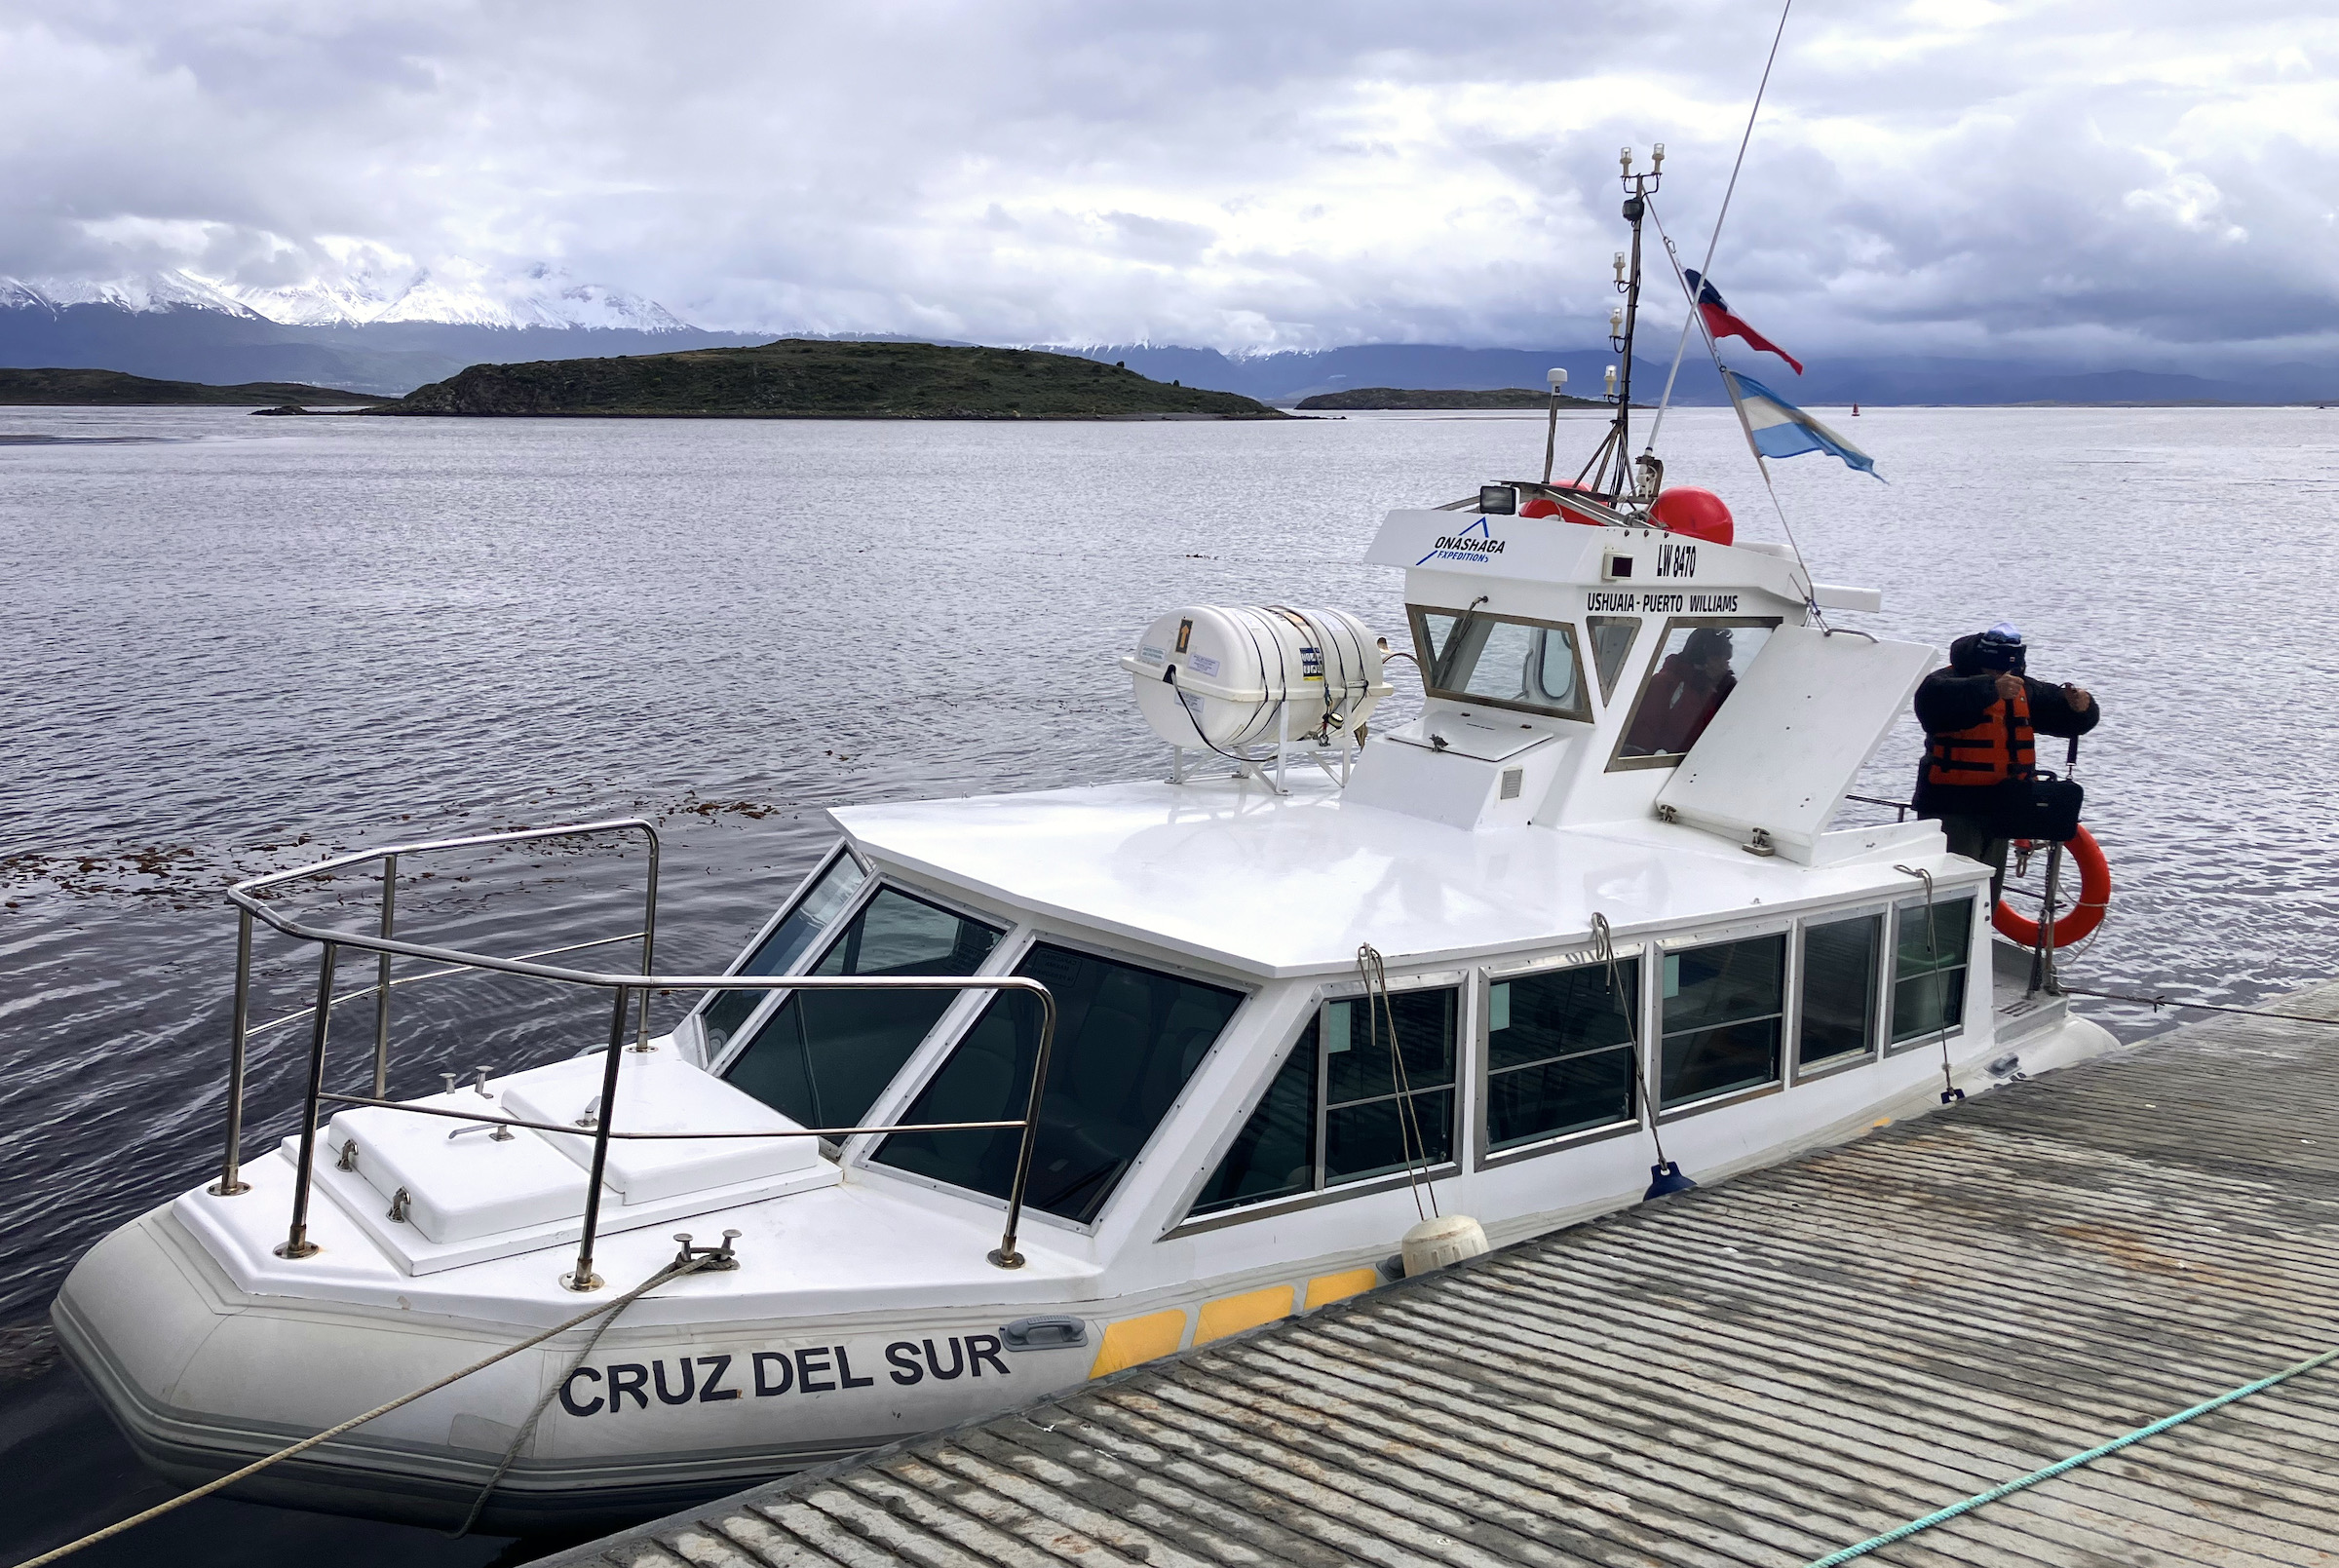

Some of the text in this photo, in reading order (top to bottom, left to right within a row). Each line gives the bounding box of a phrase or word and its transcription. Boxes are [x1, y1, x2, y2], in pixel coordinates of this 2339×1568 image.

[1435, 536, 1506, 555] ONASHAGA
[1657, 544, 1697, 578] LW 8470
[1587, 593, 1634, 612] USHUAIA
[1642, 594, 1683, 613] PUERTO
[1689, 594, 1739, 613] WILLIAMS
[558, 1334, 1012, 1418] CRUZ DEL SUR
